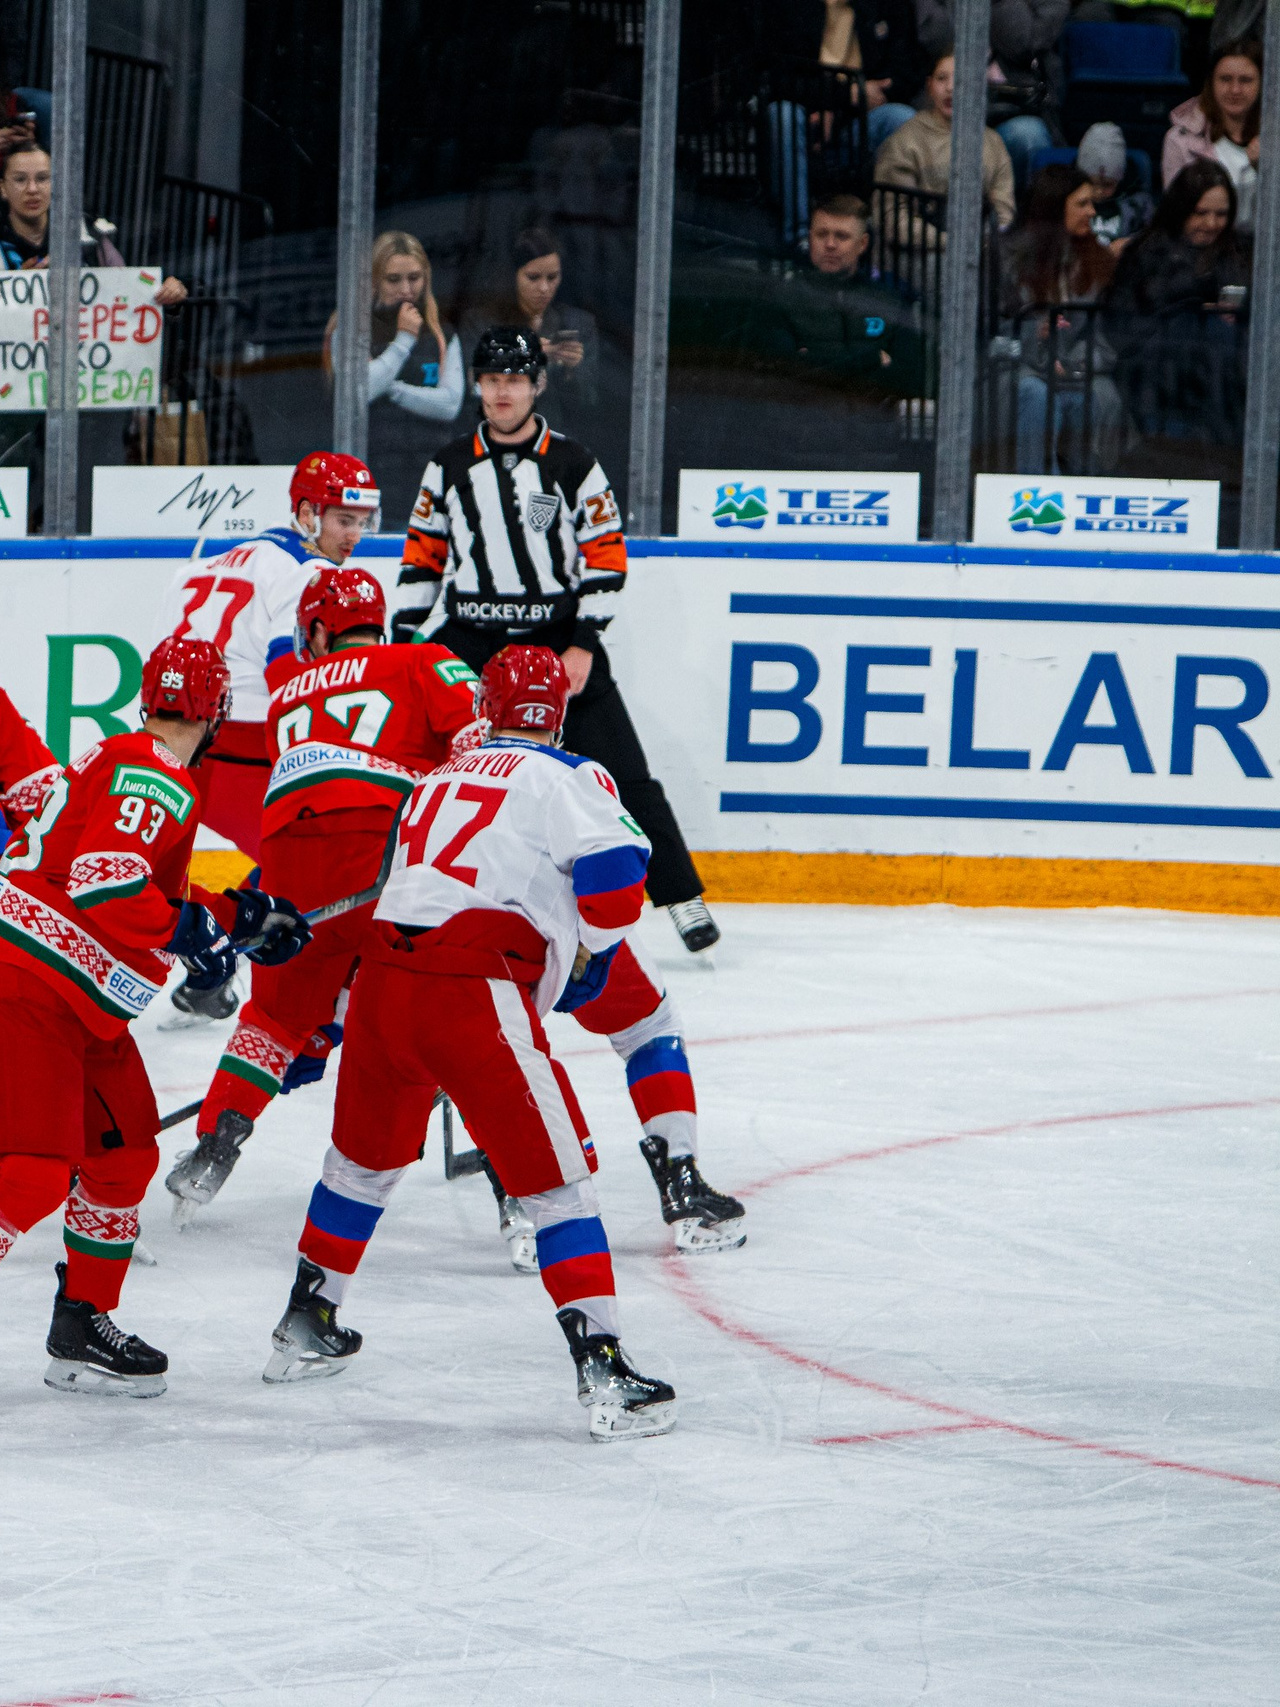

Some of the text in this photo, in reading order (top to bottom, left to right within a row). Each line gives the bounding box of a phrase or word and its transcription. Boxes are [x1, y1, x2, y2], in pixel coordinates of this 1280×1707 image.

[778, 488, 890, 510] TEZ
[1076, 494, 1189, 517] TEZ
[223, 518, 256, 531] 1953
[788, 512, 879, 526] TOUR
[1086, 519, 1176, 534] TOUR
[171, 574, 255, 652] 77
[456, 601, 555, 621] HOCKEY.BY
[522, 707, 546, 725] 42
[726, 640, 1274, 779] BELAR
[114, 796, 166, 846] 93
